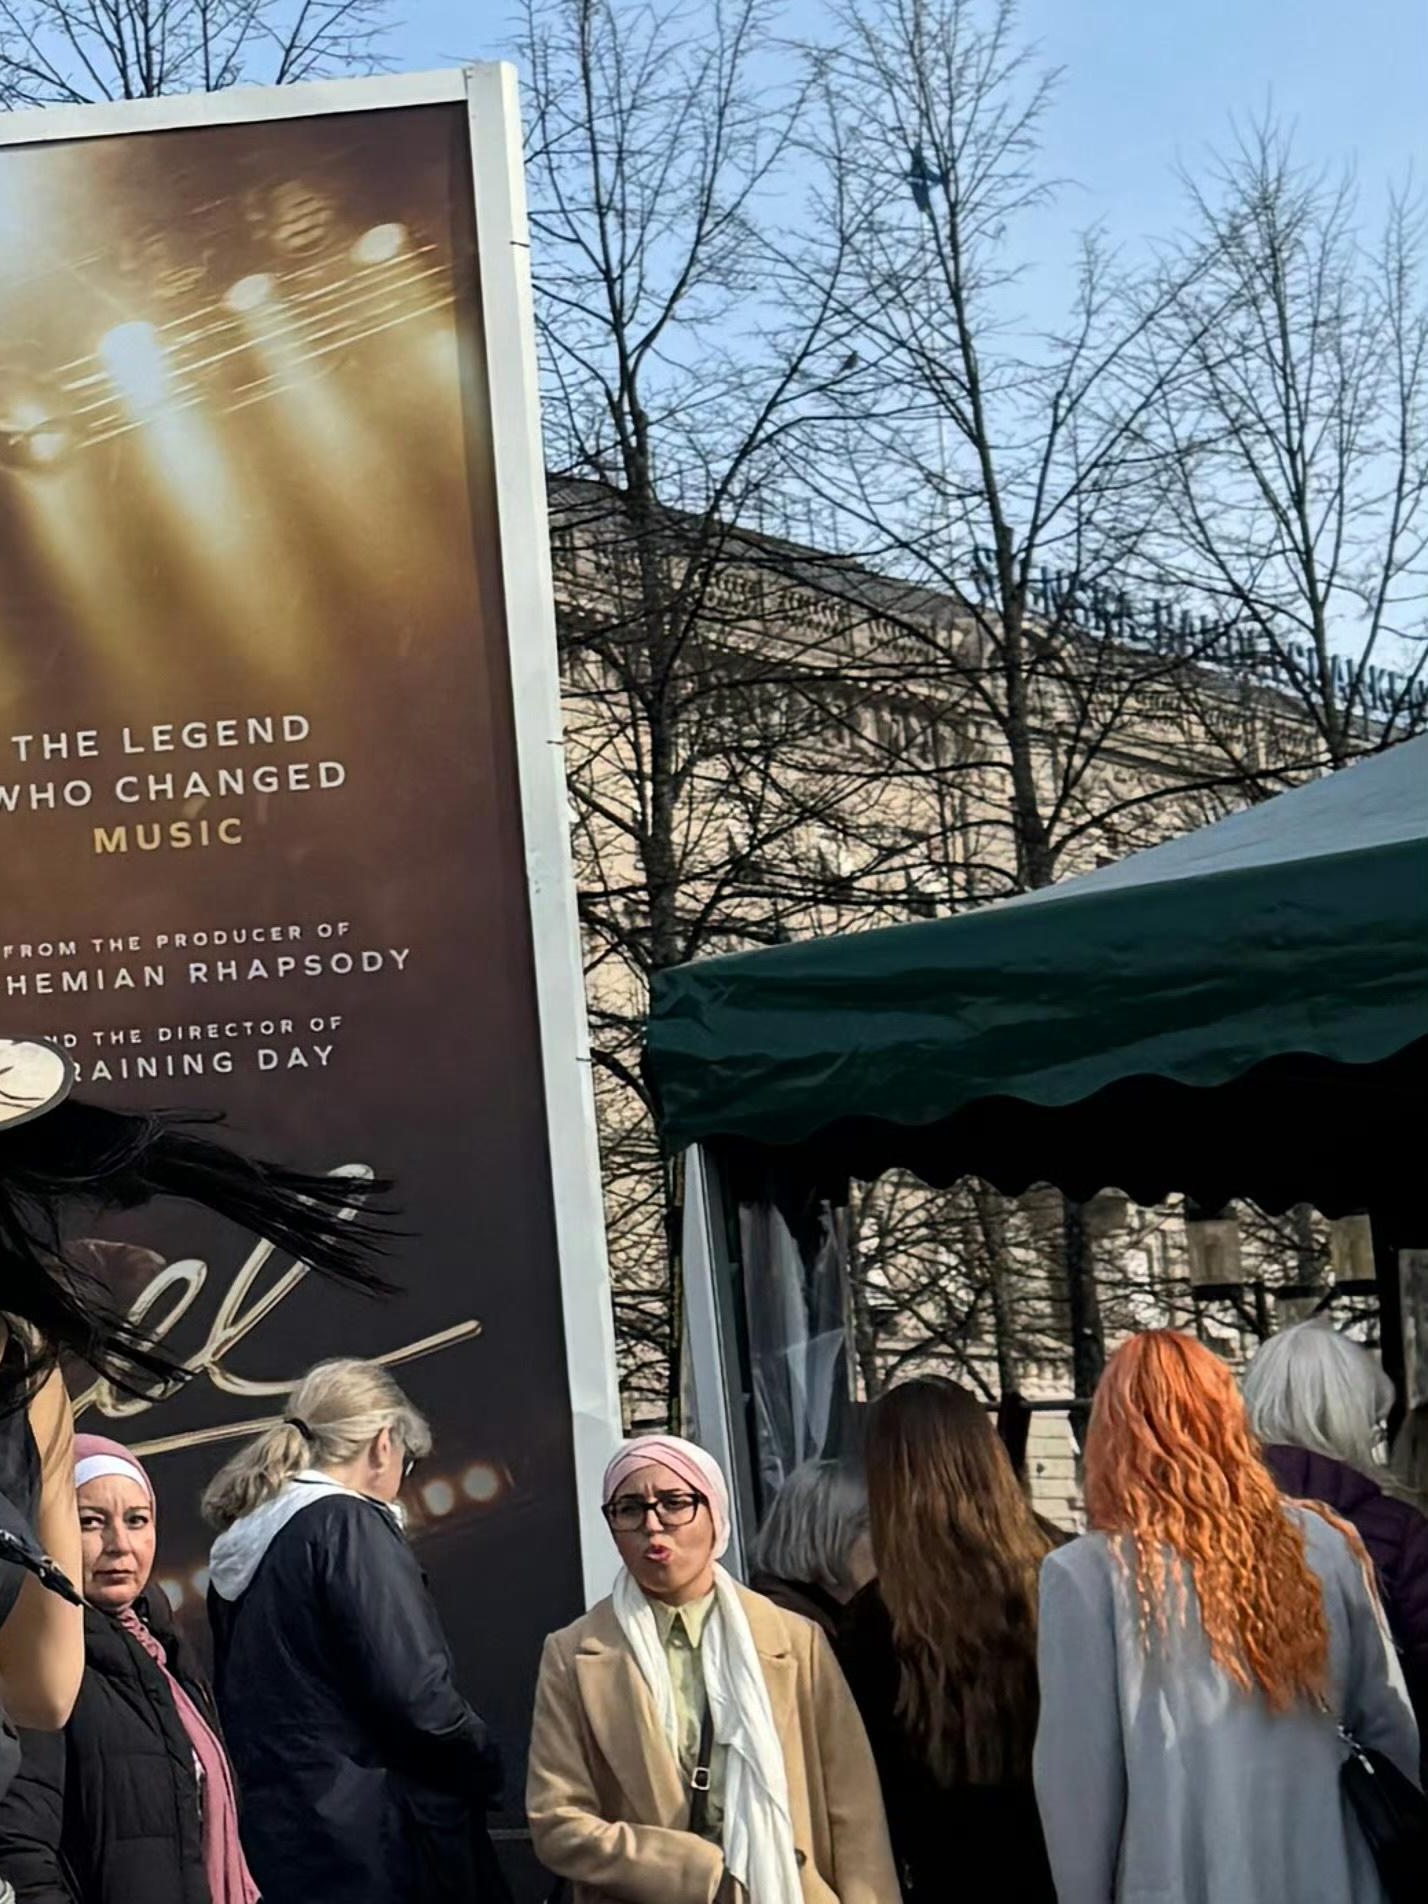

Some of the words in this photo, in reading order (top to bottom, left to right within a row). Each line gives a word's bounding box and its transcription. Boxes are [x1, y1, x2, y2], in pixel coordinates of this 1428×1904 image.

[12, 730, 99, 762] THE
[122, 714, 311, 755] LEGEND
[115, 761, 346, 803] CHANGED
[93, 818, 243, 854] MUSIC
[3, 941, 76, 958] FROM
[91, 936, 141, 953] THE
[156, 925, 302, 949] PRODUCER
[318, 922, 350, 938] OF
[190, 949, 411, 984] RHAPSODY
[93, 1029, 142, 1046] THE
[158, 1020, 295, 1042] DIRECTOR
[310, 1016, 343, 1032] OF
[258, 1045, 334, 1071] DAY
